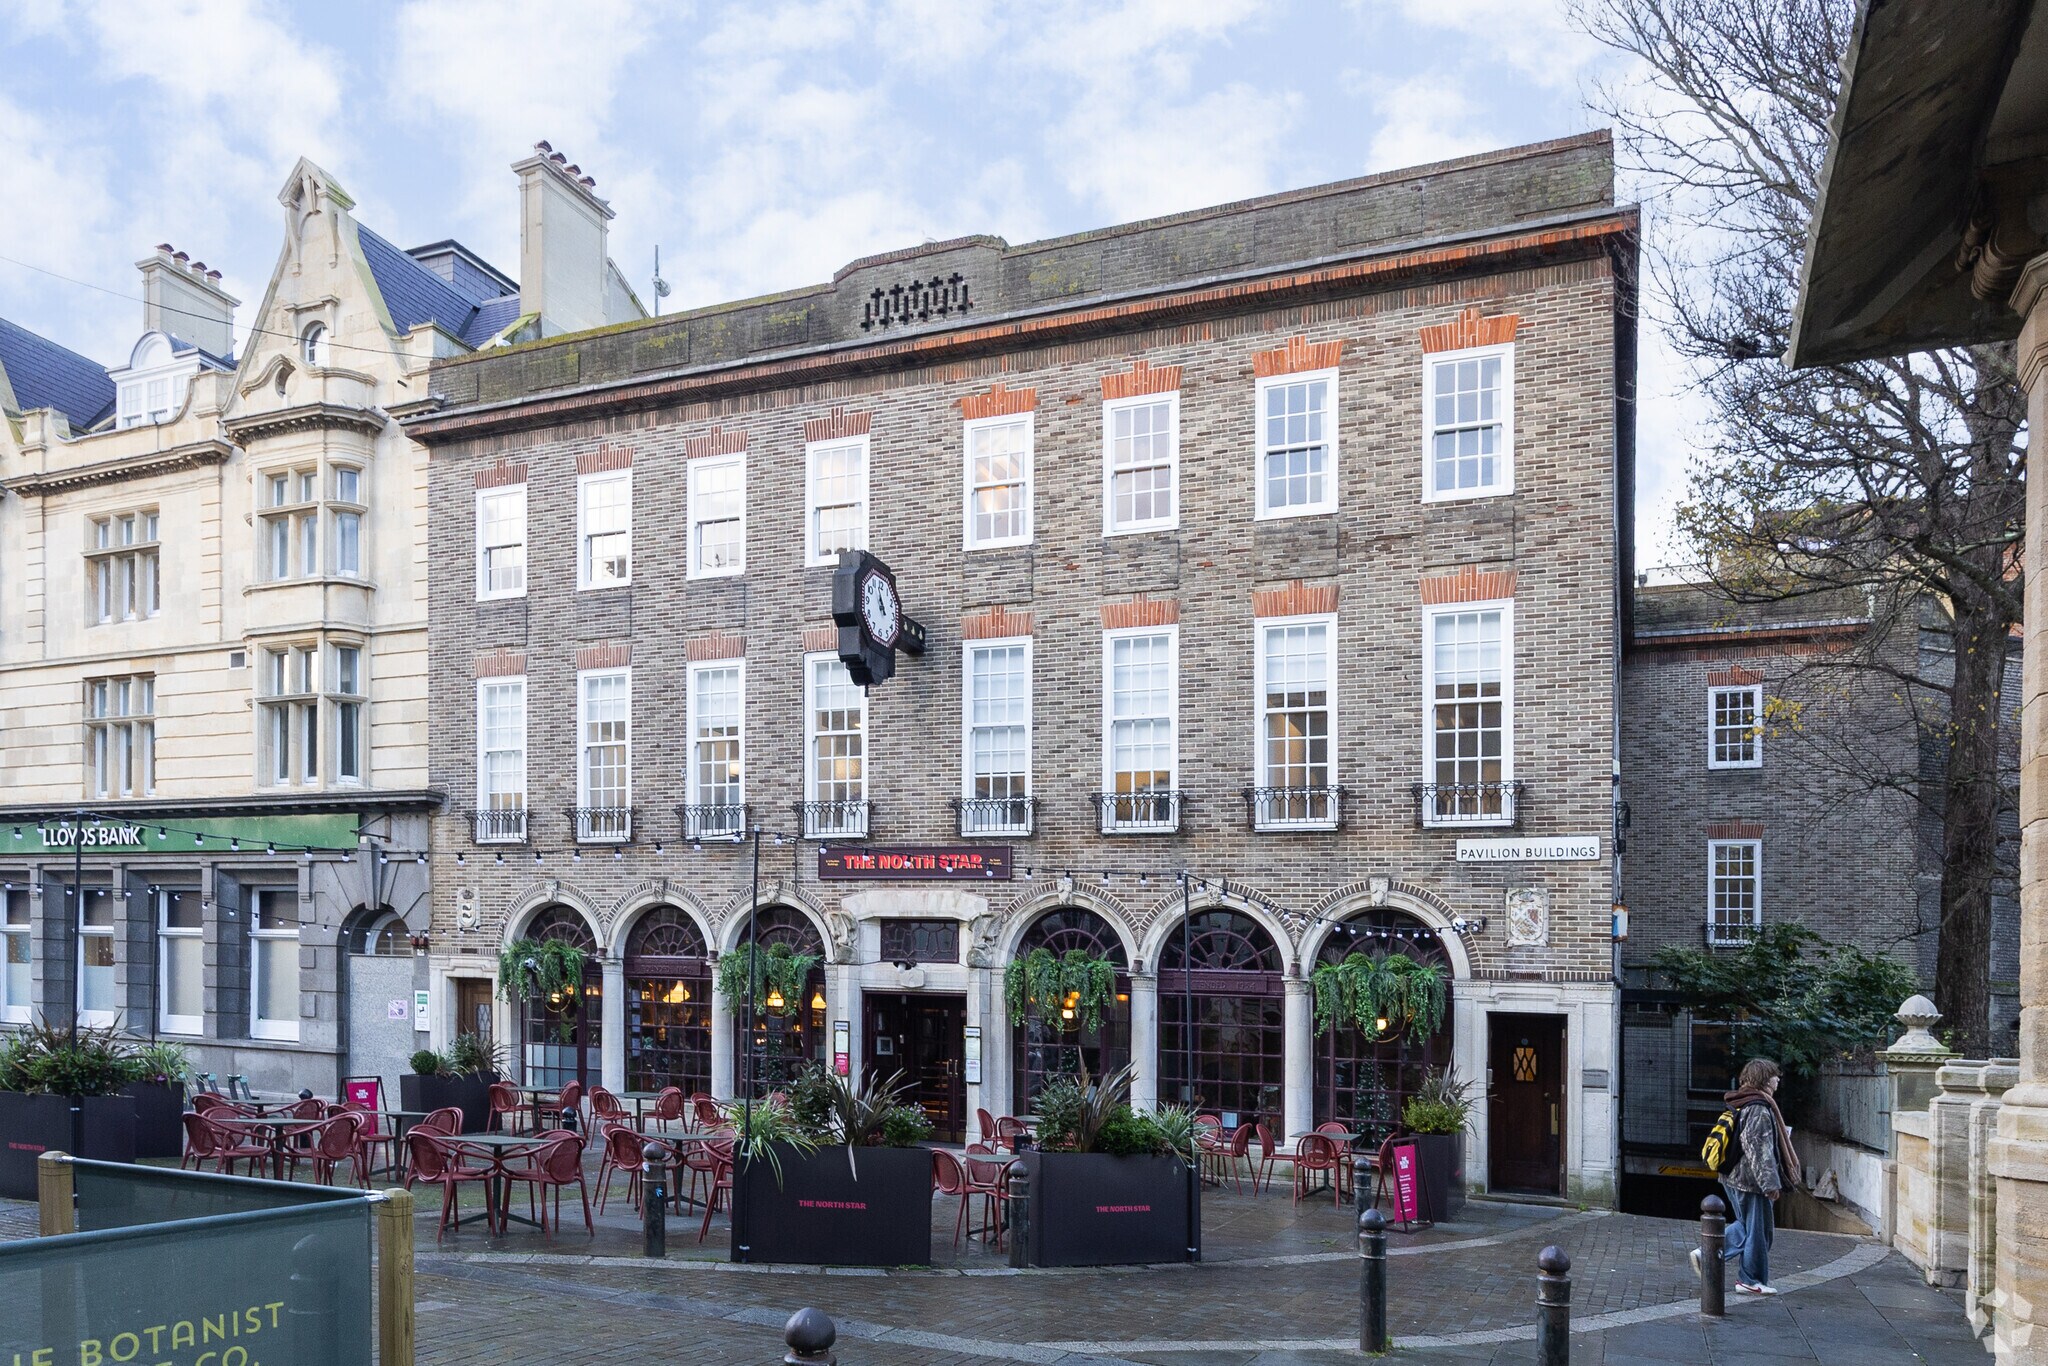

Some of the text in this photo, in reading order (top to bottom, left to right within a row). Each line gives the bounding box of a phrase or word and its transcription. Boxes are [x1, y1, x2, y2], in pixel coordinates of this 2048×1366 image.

[43, 826, 140, 846] LLOYDS BANK
[844, 855, 876, 870] THE
[878, 854, 935, 870] NORTH
[938, 853, 983, 869] STAR
[1461, 846, 1596, 859] PAVILION BUILDINGS
[81, 1301, 285, 1366] BOTANIST
